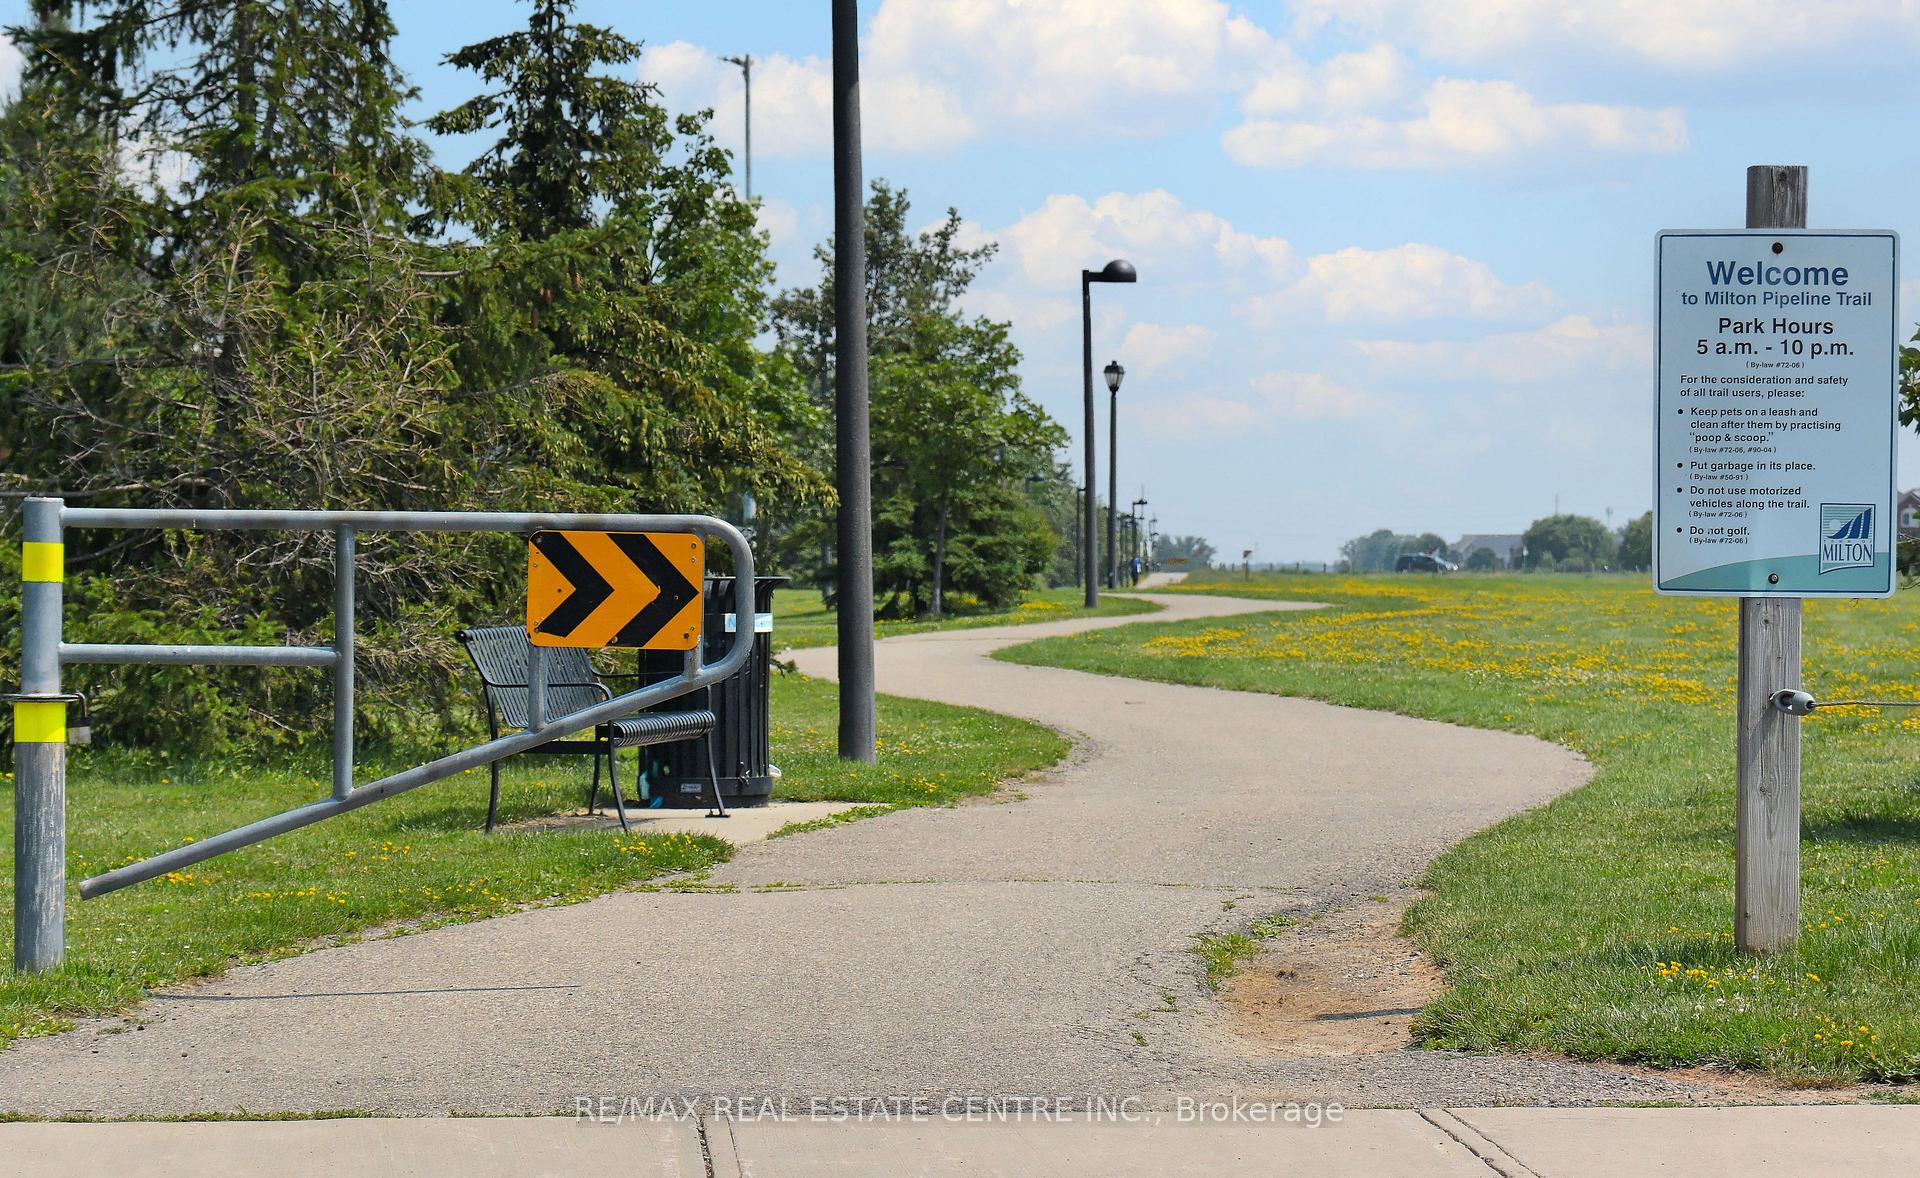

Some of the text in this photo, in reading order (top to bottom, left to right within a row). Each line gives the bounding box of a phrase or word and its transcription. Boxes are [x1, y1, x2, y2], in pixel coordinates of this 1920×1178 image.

[1706, 261, 1849, 286] Welcome
[1681, 291, 1872, 308] to Milton Pipeline Trail
[1718, 317, 1834, 335] Park Hours
[1696, 339, 1708, 356] 5
[1715, 342, 1758, 355] a.m.
[1780, 339, 1804, 355] 10
[1811, 342, 1854, 359] p.m.
[1680, 375, 1849, 387] For the consideration and safety
[1680, 388, 1805, 400] of all trail users, please:
[1690, 407, 1818, 419] Keep pets on a leash and
[1690, 420, 1841, 431] clean after them by practising
[1724, 433, 1732, 442] &
[1690, 461, 1816, 472] Put garbage in its place.
[1690, 486, 1705, 495] Do
[1707, 486, 1725, 495] not
[1749, 486, 1801, 496] motorized
[1689, 500, 1810, 510] vehicles along the trail.
[1689, 526, 1750, 537] Do not golf.
[1822, 543, 1873, 561] MILTON
